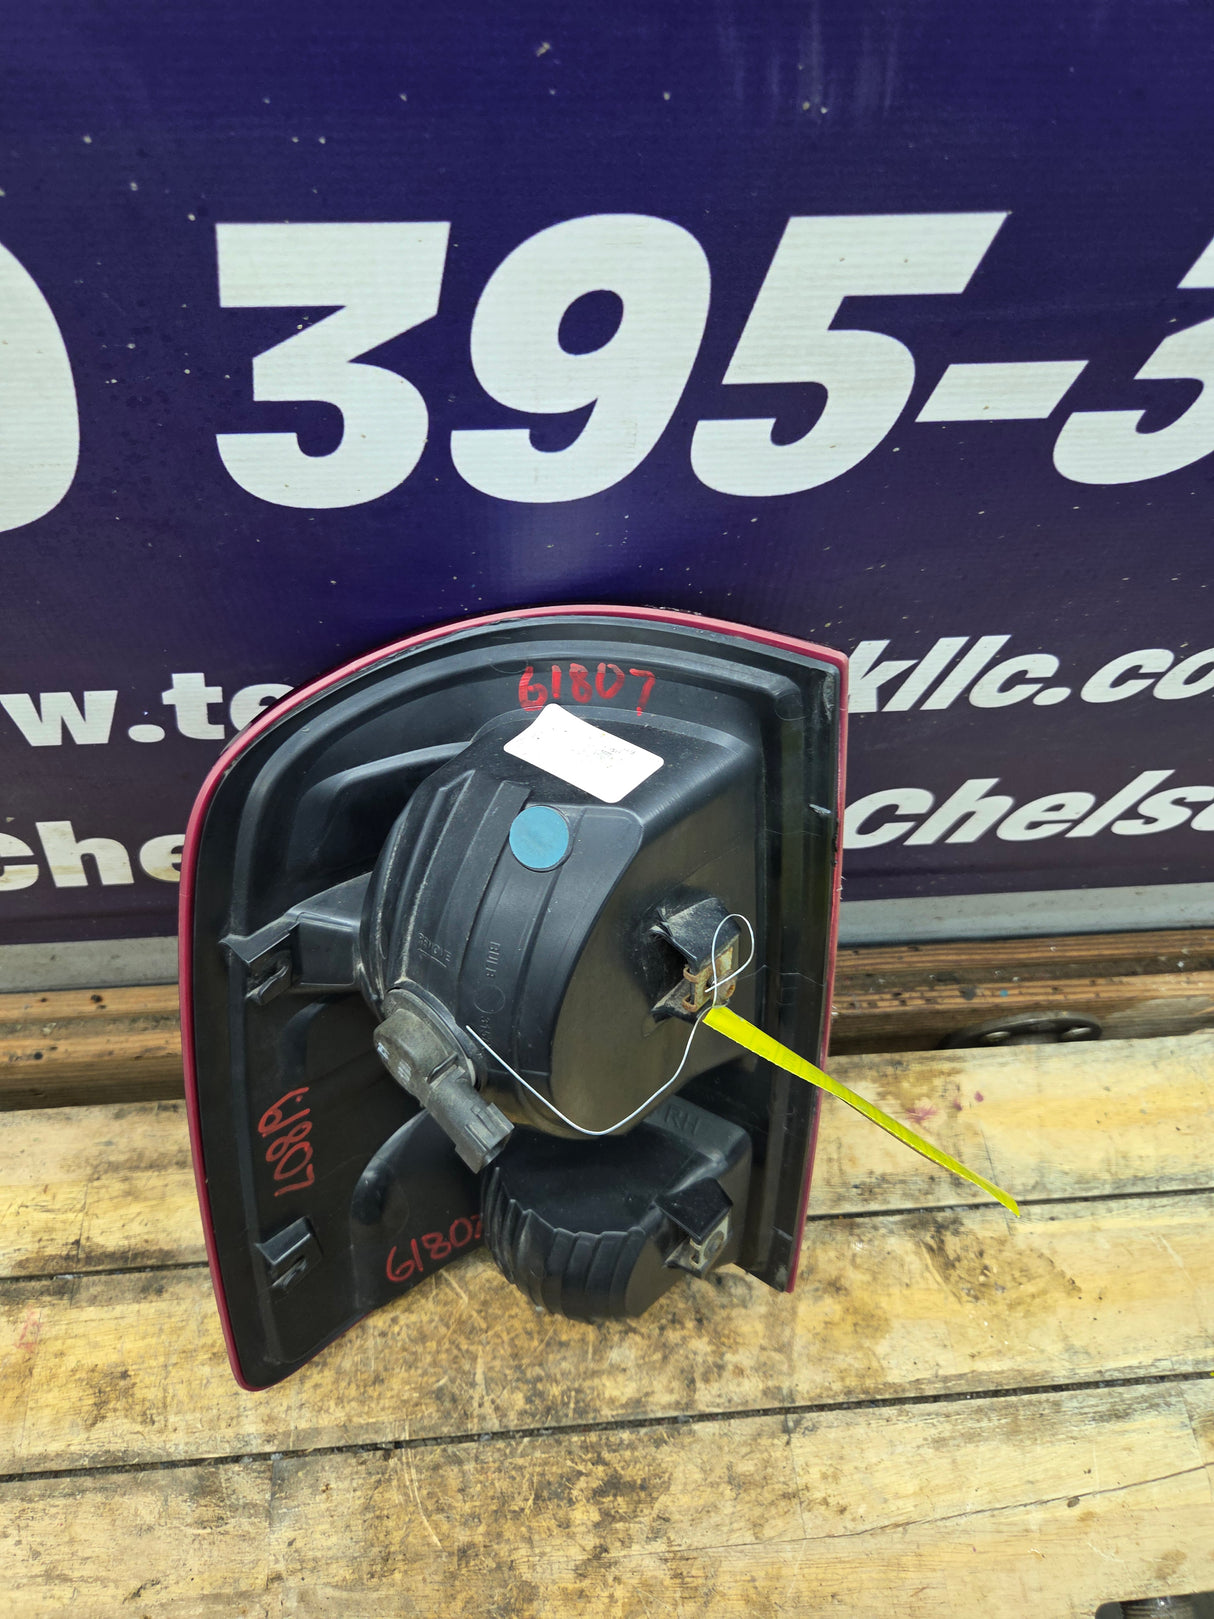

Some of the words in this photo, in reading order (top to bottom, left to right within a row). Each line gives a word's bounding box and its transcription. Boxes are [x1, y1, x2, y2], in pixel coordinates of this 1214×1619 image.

[518, 662, 656, 717] 61807
[258, 1086, 315, 1197] 61807
[664, 1103, 699, 1136] RH
